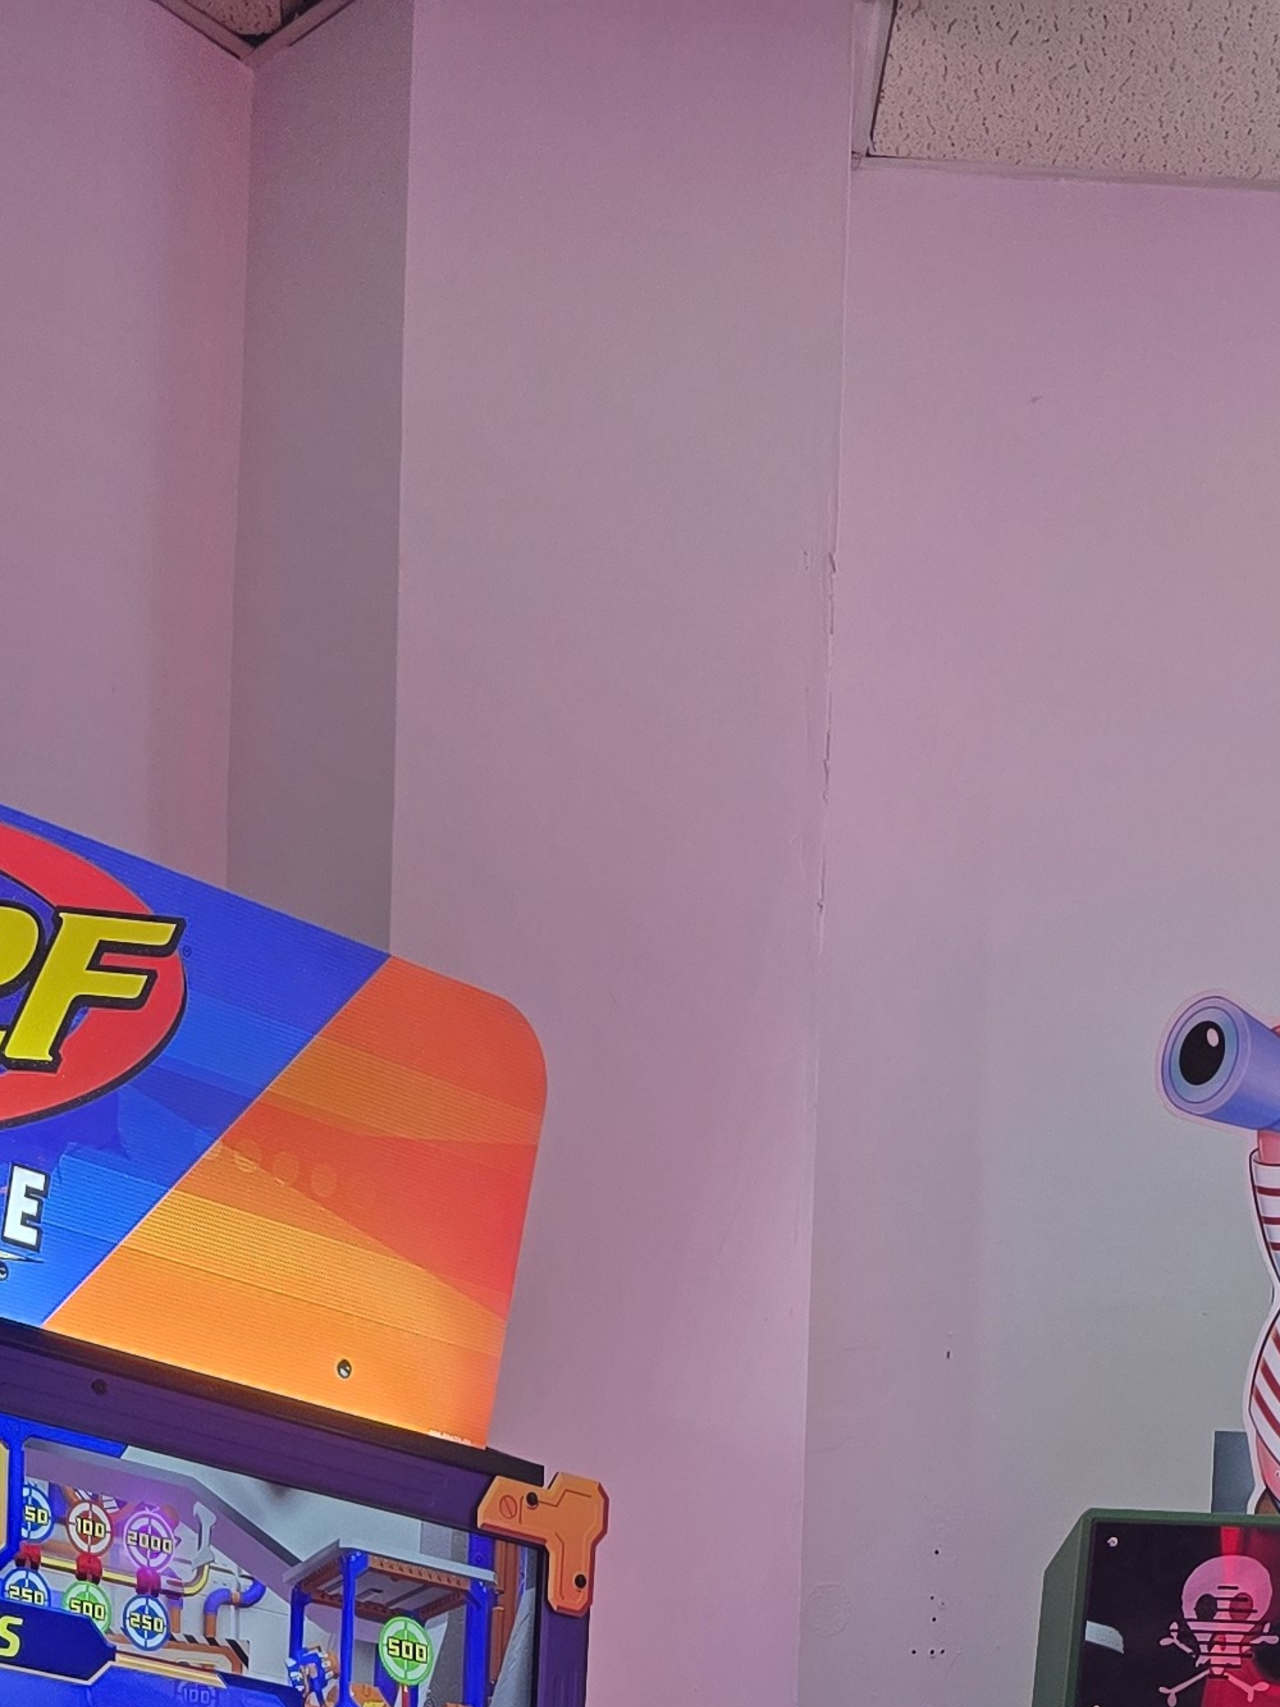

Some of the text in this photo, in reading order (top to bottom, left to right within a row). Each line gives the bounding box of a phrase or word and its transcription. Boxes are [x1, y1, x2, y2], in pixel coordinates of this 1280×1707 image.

[74, 1518, 106, 1539] 100
[127, 1530, 174, 1554] 2000
[69, 1597, 106, 1619] 500
[130, 1611, 165, 1634] 250
[387, 1638, 428, 1666] 500
